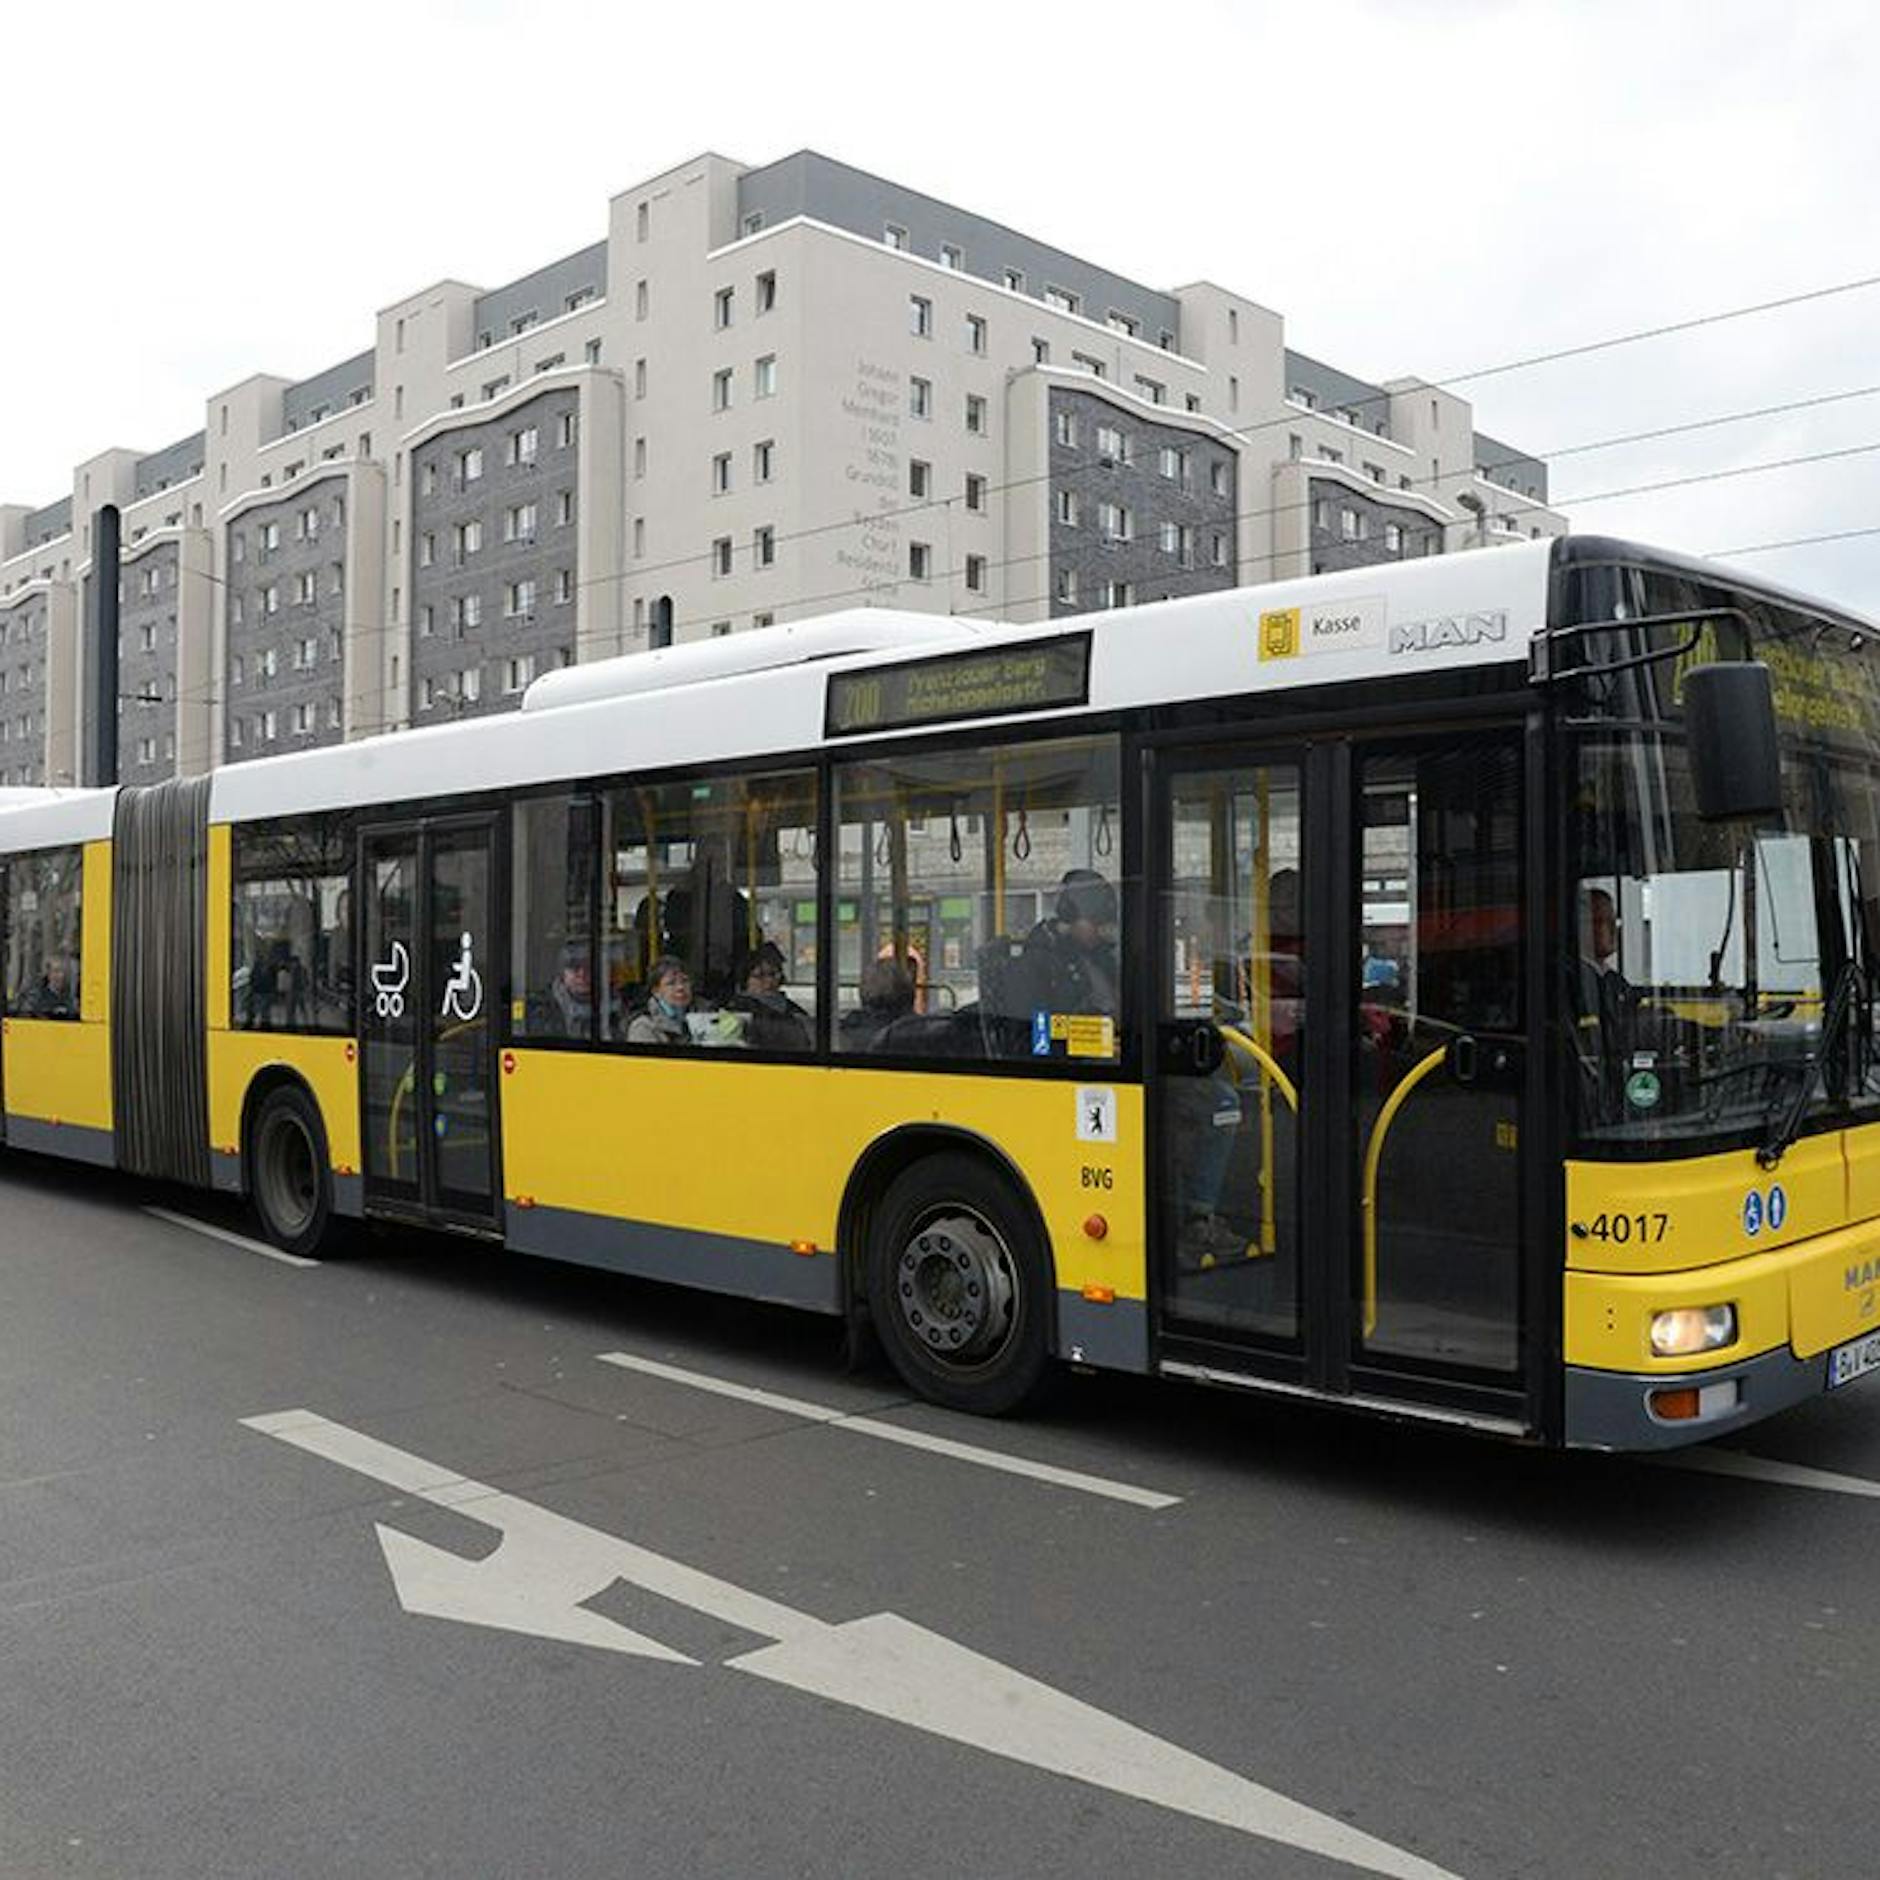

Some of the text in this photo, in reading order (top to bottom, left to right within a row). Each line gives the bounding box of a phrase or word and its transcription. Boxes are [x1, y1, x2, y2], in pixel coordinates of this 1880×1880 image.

[1313, 615, 1361, 636] Kasse
[1389, 611, 1506, 655] MAN
[1081, 1166, 1114, 1190] BVG
[1591, 1213, 1668, 1243] 4017
